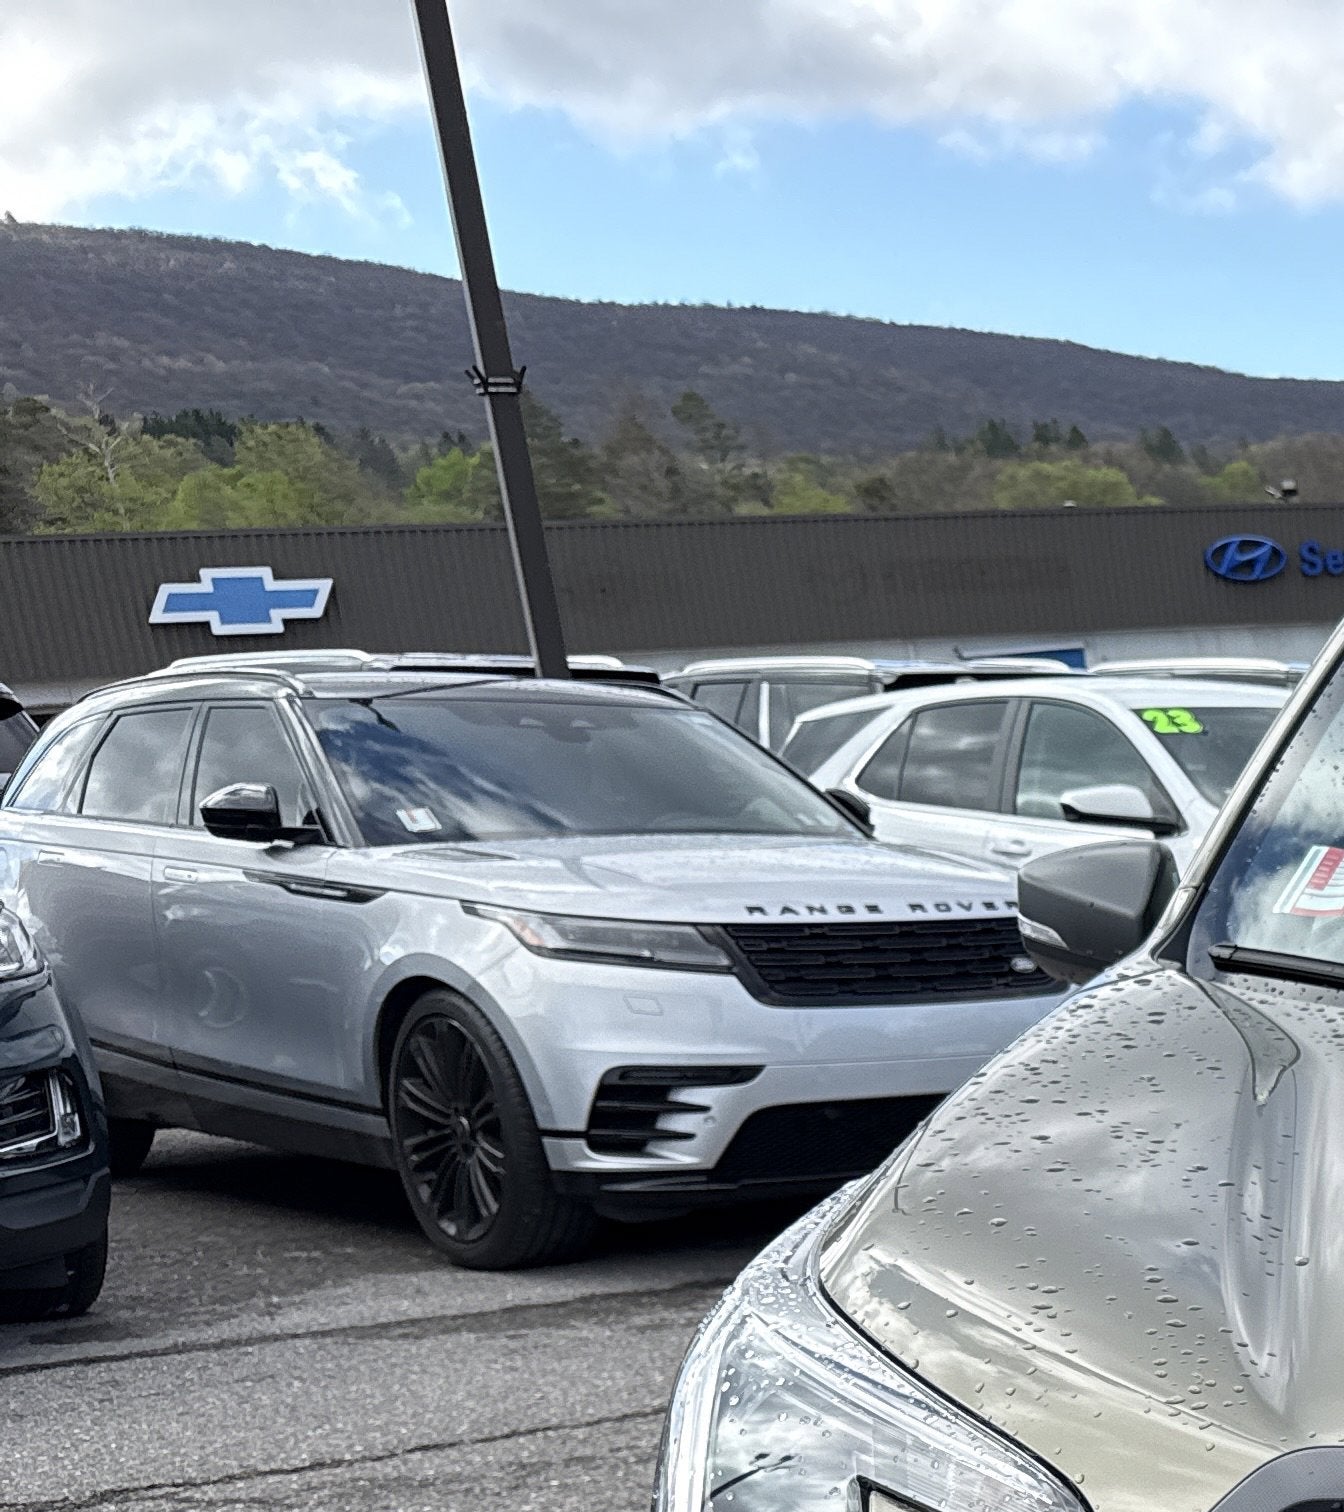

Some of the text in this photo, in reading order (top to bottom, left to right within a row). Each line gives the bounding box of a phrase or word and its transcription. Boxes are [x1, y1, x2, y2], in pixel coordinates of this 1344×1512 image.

[1142, 708, 1204, 734] 23
[745, 901, 1019, 916] RANGE ROVER
